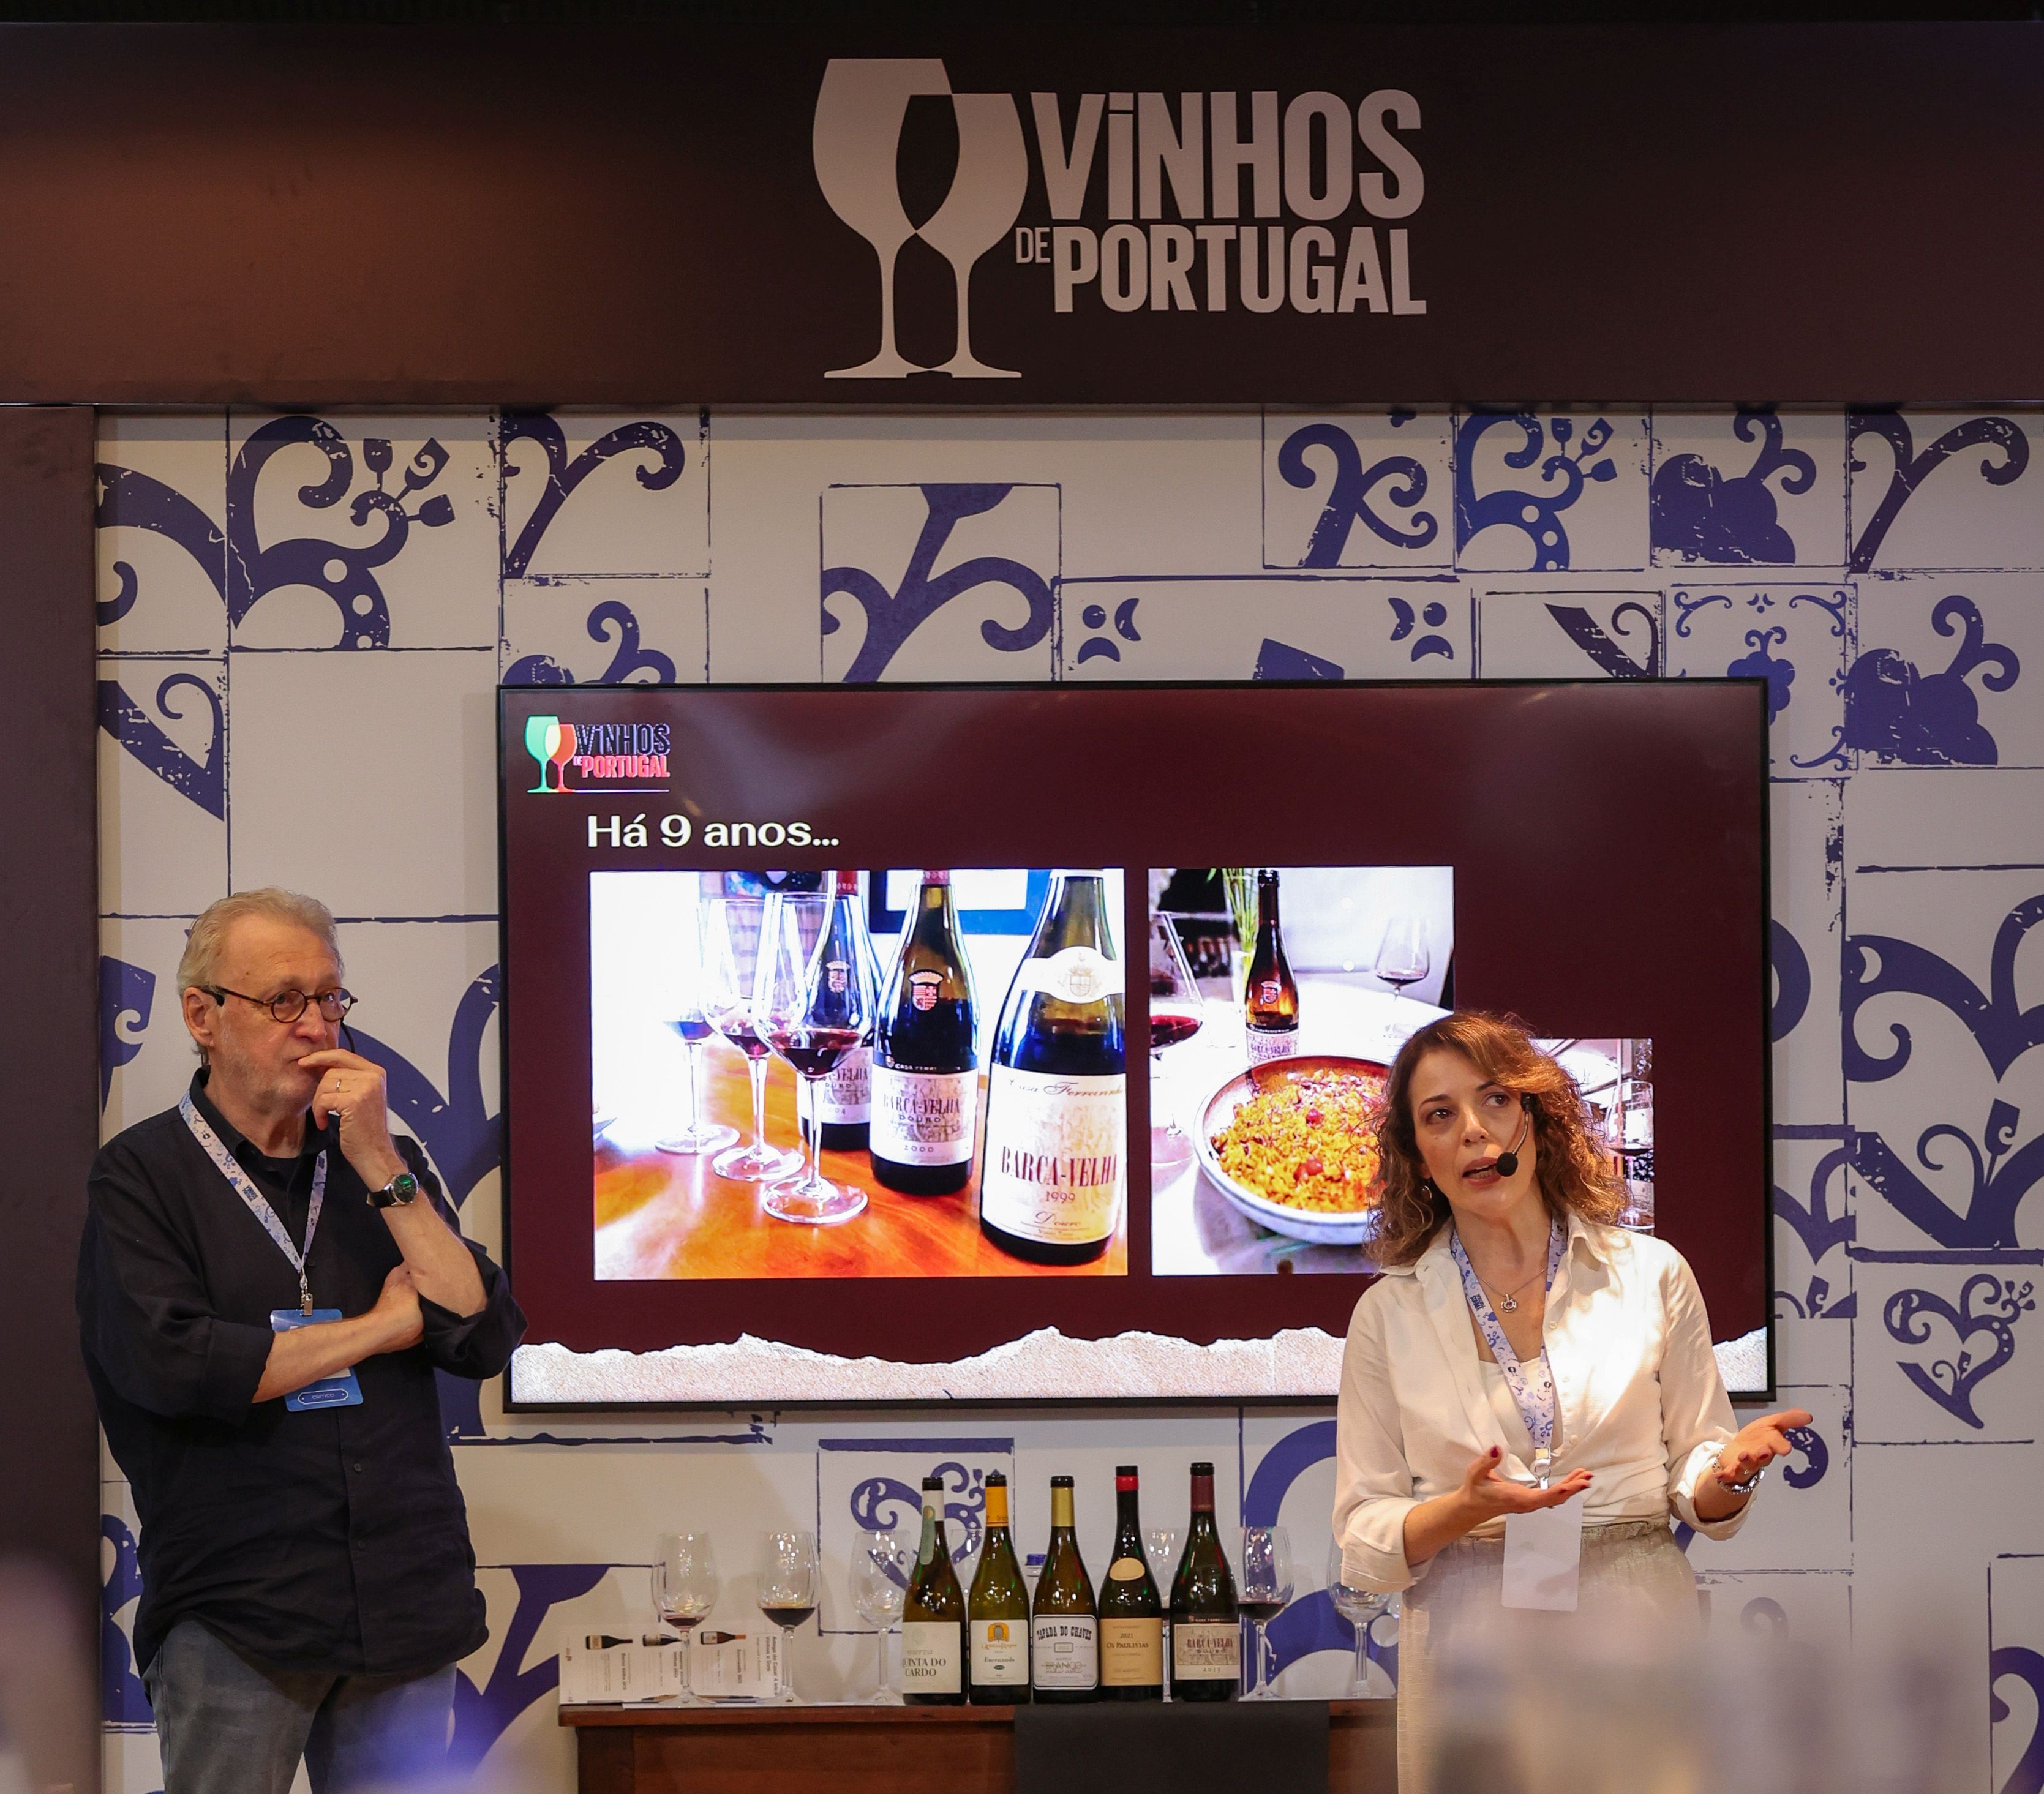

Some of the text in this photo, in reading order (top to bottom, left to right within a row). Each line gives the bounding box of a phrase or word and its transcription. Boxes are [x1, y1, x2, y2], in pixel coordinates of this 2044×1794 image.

[1015, 224, 1427, 315] DE PORTUGAL
[582, 755, 671, 778] PORTUGAL
[588, 813, 840, 847] Há 9 anos...
[1037, 1626, 1092, 1642] TAPADA DO CHAVES
[906, 1668, 937, 1676] CARDO
